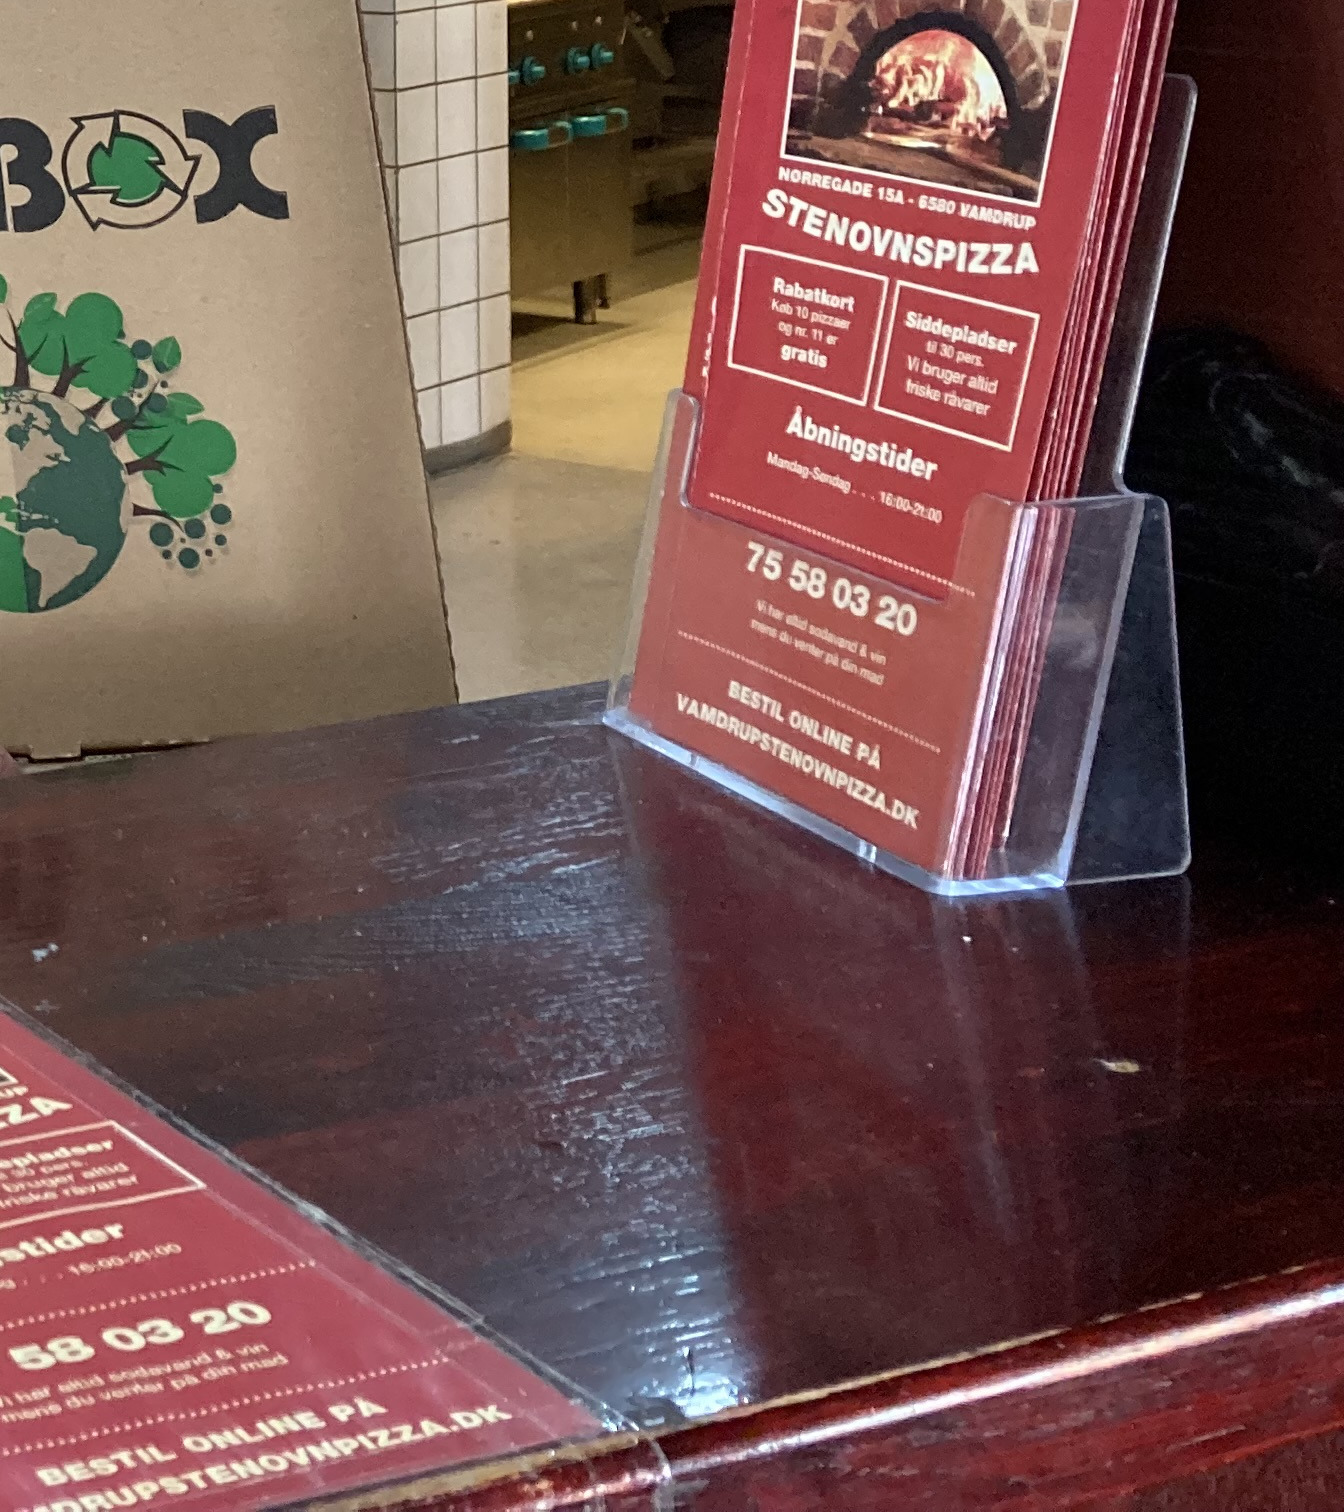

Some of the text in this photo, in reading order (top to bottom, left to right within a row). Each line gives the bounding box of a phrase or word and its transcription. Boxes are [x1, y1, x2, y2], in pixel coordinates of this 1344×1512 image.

[877, 186, 905, 205] 15A
[918, 194, 956, 215] 6580
[959, 201, 1037, 231] VAMDRUP
[762, 188, 1040, 275] STENOVNSPIZZA
[773, 276, 855, 313] Rabatkort
[795, 305, 810, 320] 10
[905, 311, 1018, 355] Siddepladser
[939, 345, 955, 358] 30
[780, 344, 828, 368] gratis
[907, 355, 999, 394] Vi bruger altid
[906, 379, 991, 416] friske råvarer
[786, 405, 938, 480] Åbningstider
[746, 541, 918, 636] 75 58 03 20
[870, 649, 887, 666] vin
[727, 680, 881, 770] BESTIL ONLINE PÅ
[676, 692, 920, 829] VAMDRUPSTENOVNPIZZA.DK
[8, 1335, 96, 1372] 58
[101, 1316, 186, 1352] 03
[189, 1300, 273, 1336] 20
[22, 1404, 514, 1512] DRUPSTENOVNPIZZA.DK
[35, 1395, 388, 1486] BESTIL ONLINE PÅ
